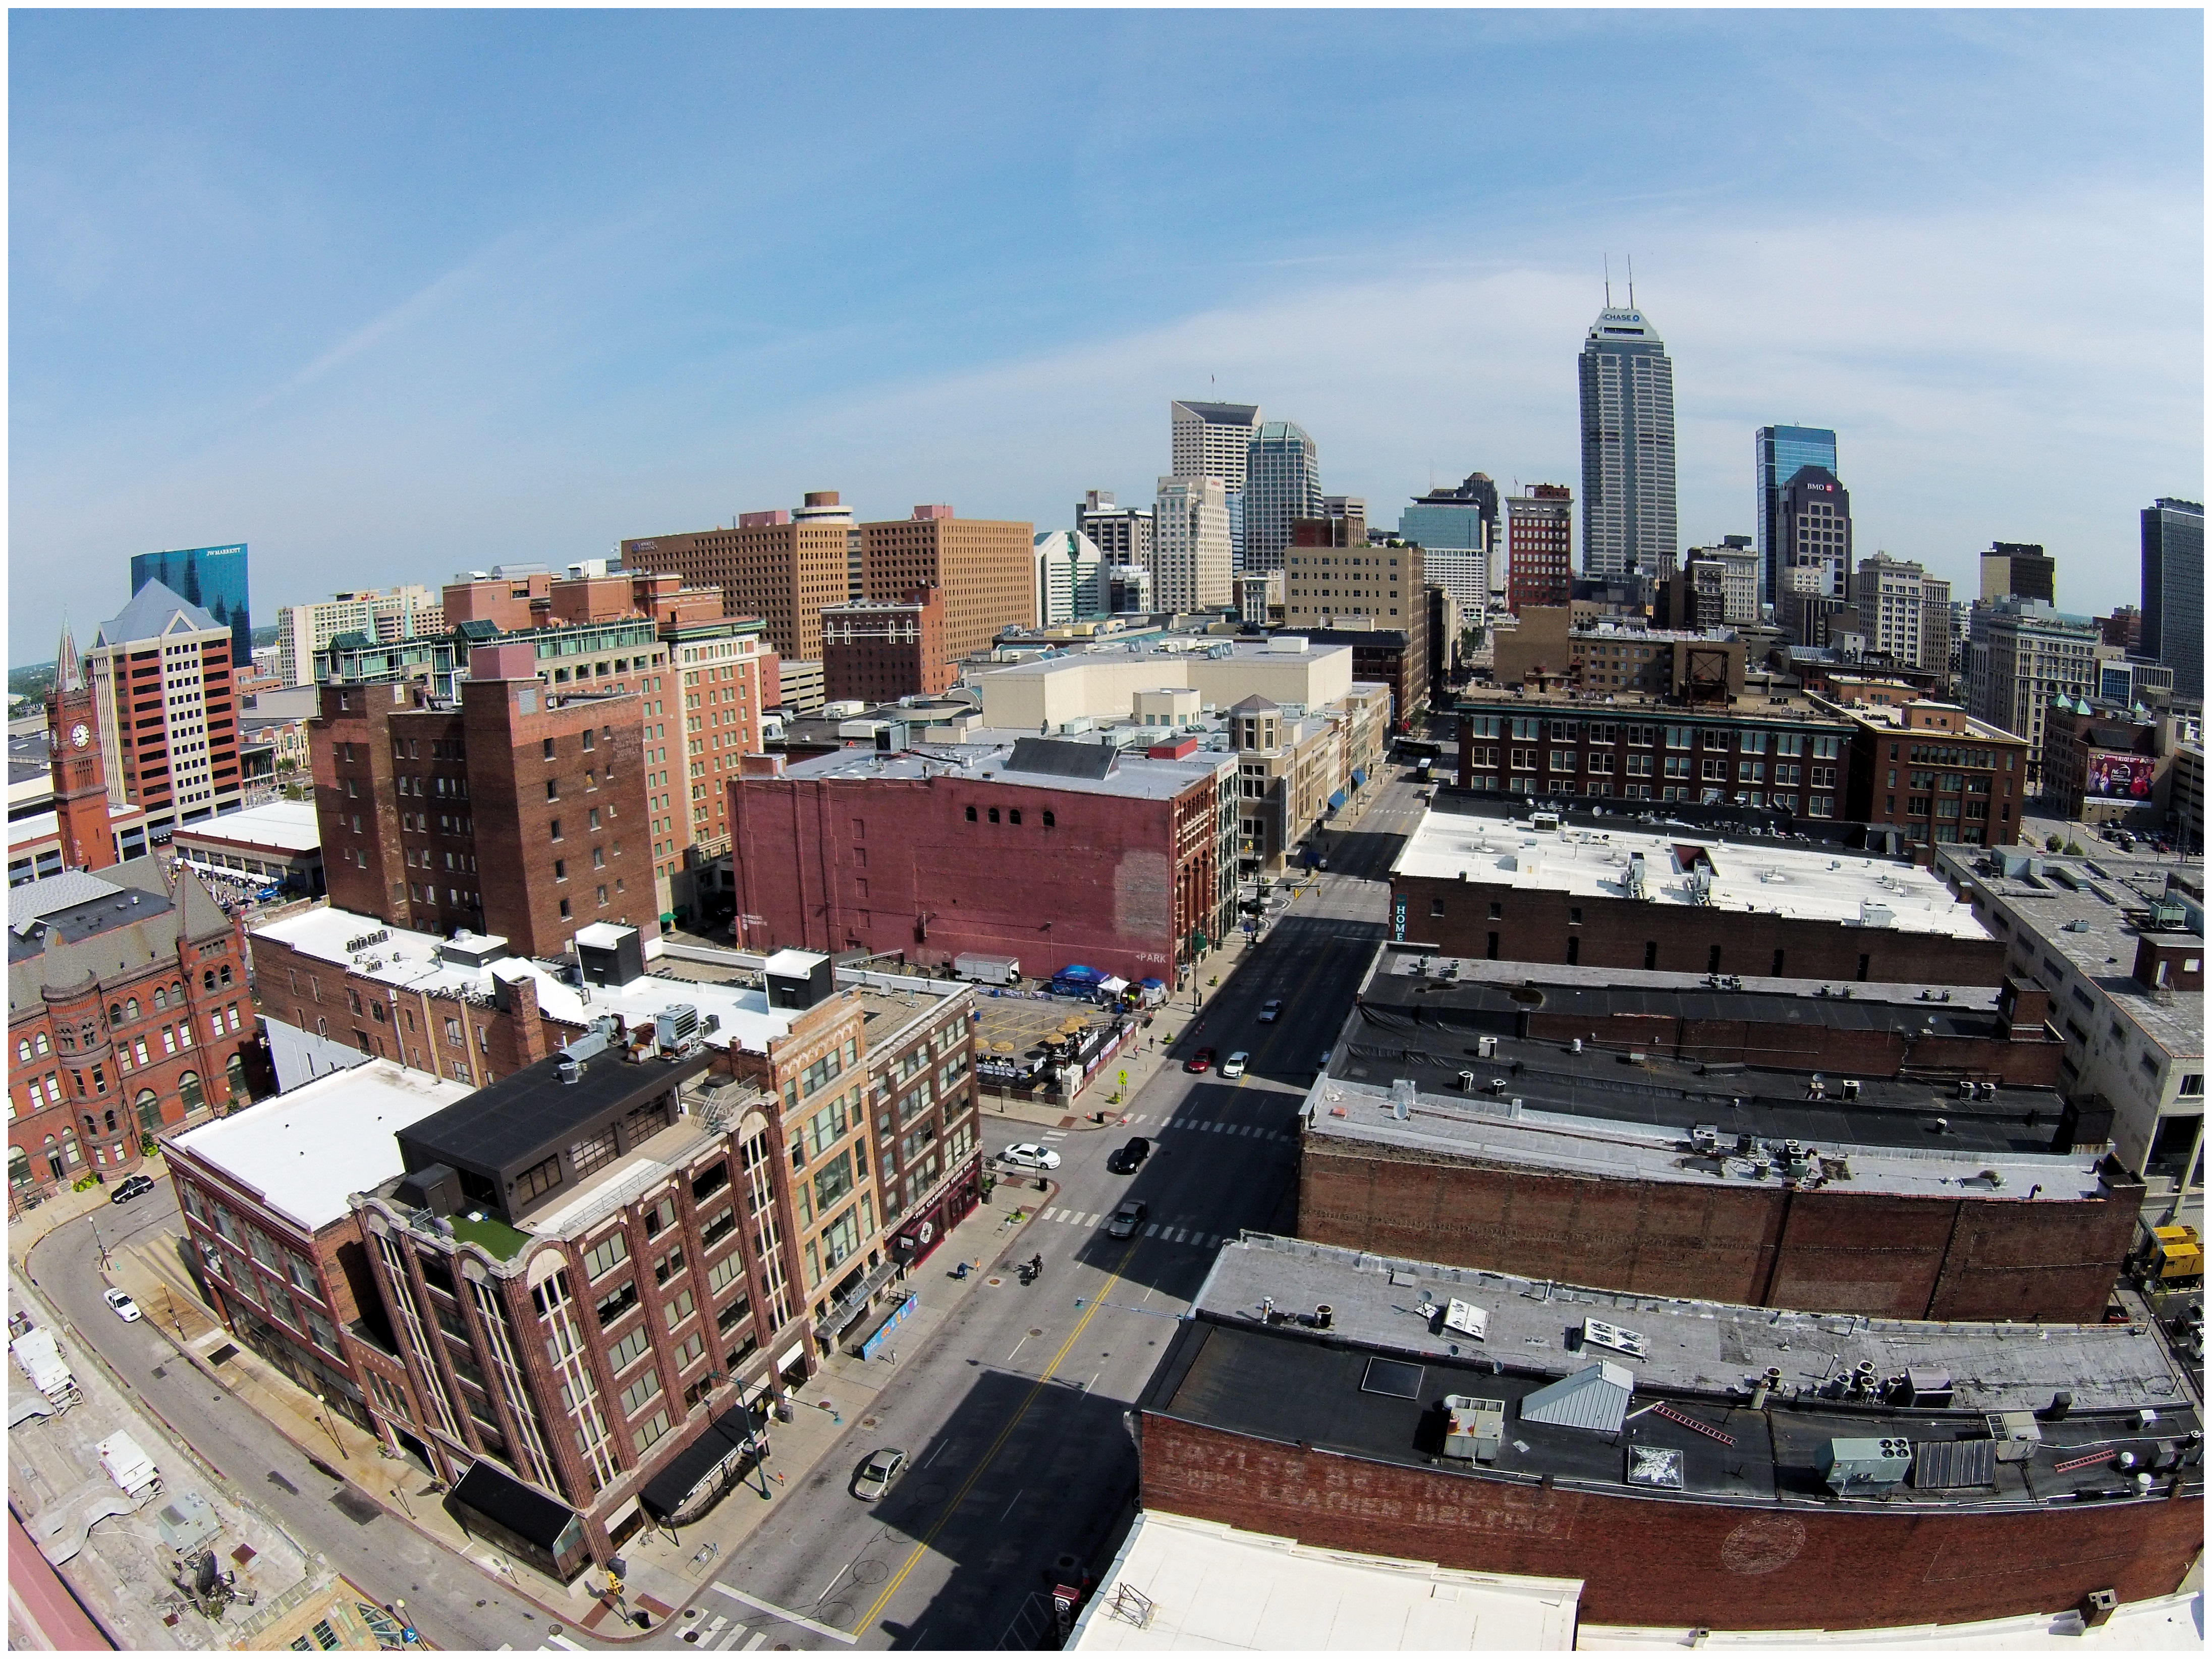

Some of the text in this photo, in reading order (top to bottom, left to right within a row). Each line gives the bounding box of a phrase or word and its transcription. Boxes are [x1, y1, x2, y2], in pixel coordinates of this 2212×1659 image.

[214, 547, 241, 556] MARRIOTT
[1395, 906, 1405, 942] HOME
[1140, 953, 1167, 963] PARK
[915, 1160, 974, 1219] THE CLADDAGH IRISH PUB
